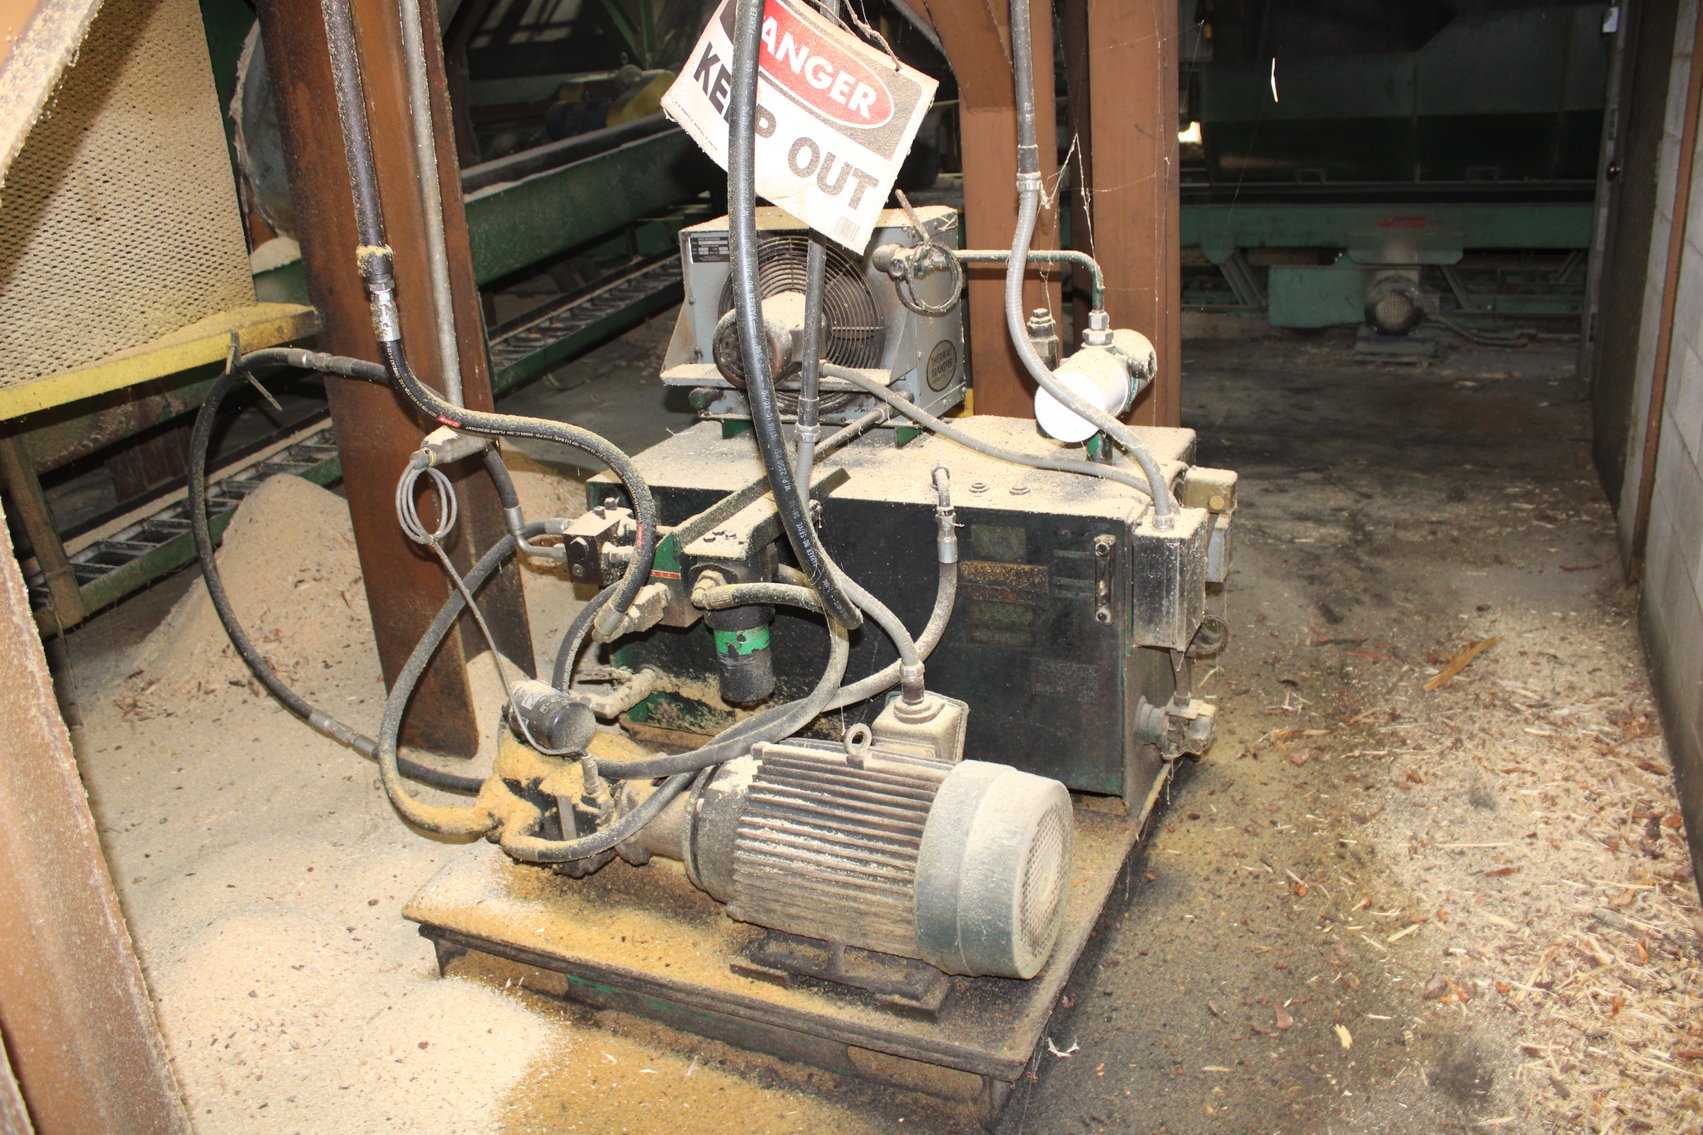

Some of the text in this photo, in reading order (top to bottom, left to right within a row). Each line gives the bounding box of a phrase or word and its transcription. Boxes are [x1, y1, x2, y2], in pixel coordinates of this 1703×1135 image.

[693, 41, 777, 139] KEP
[787, 136, 880, 211] OUT
[760, 15, 877, 120] ANGER
